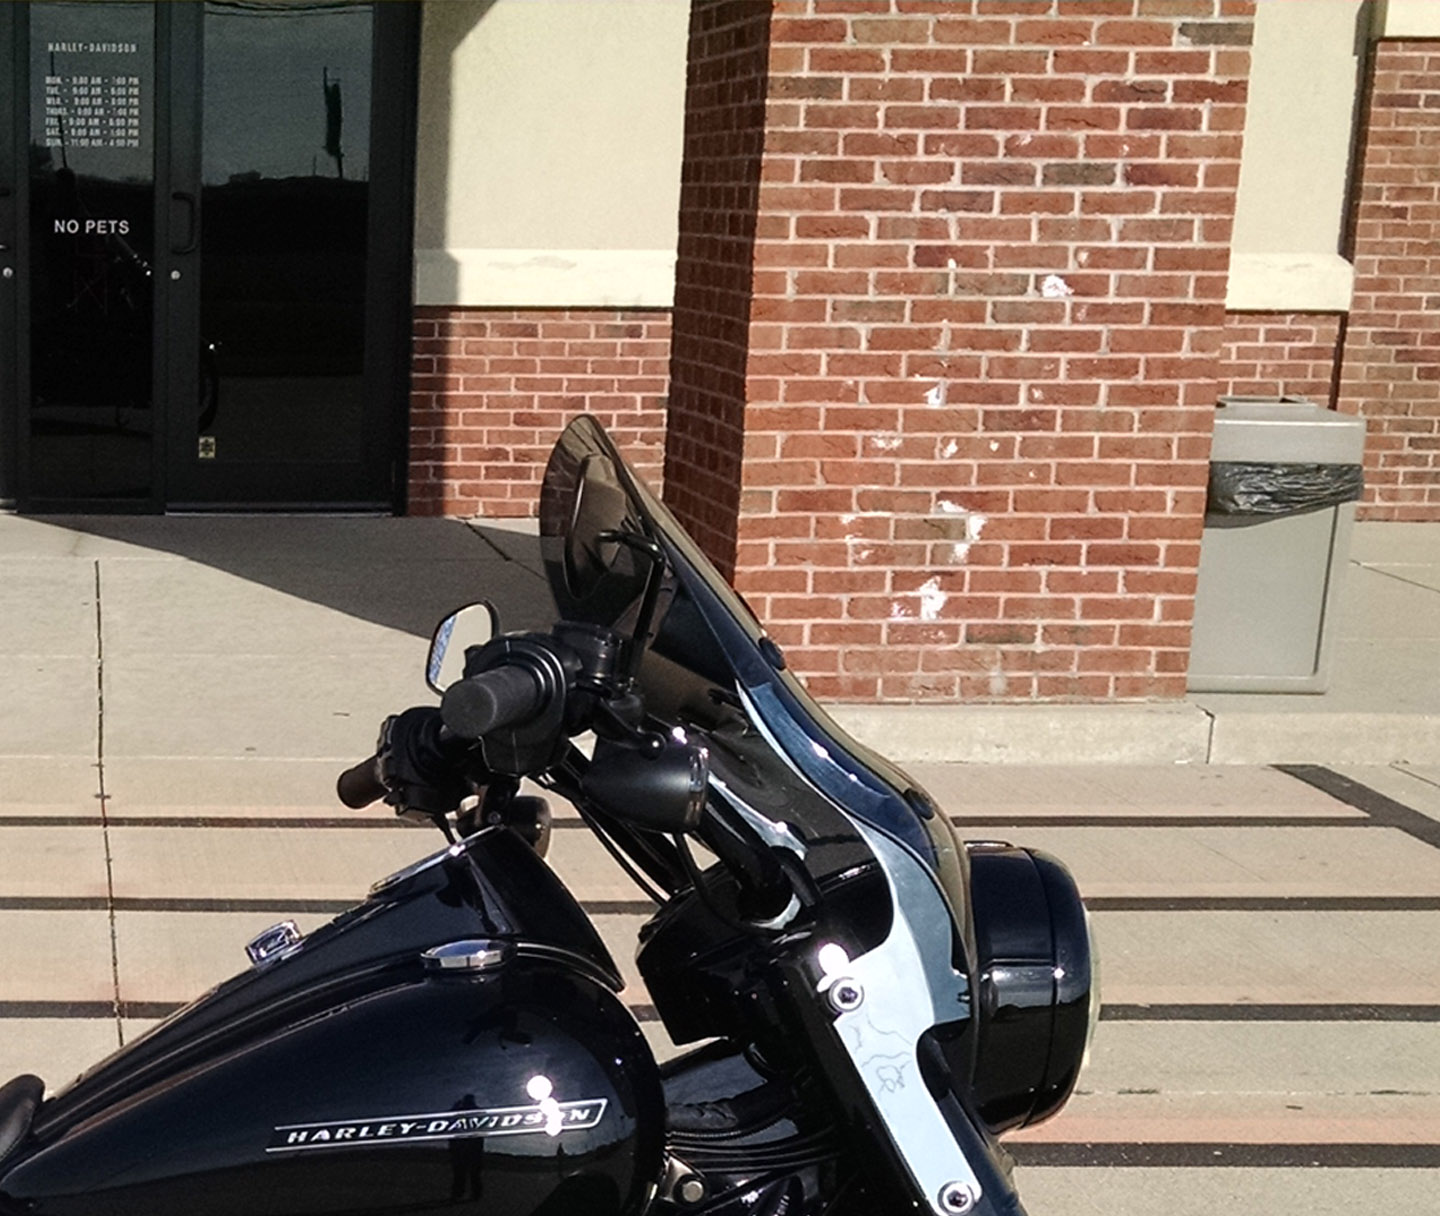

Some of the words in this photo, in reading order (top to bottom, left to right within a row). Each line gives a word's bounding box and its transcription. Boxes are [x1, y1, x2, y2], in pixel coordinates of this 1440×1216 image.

[48, 42, 137, 53] HARLEY-DAVIDSON
[53, 219, 79, 234] NO
[85, 220, 130, 235] PETS
